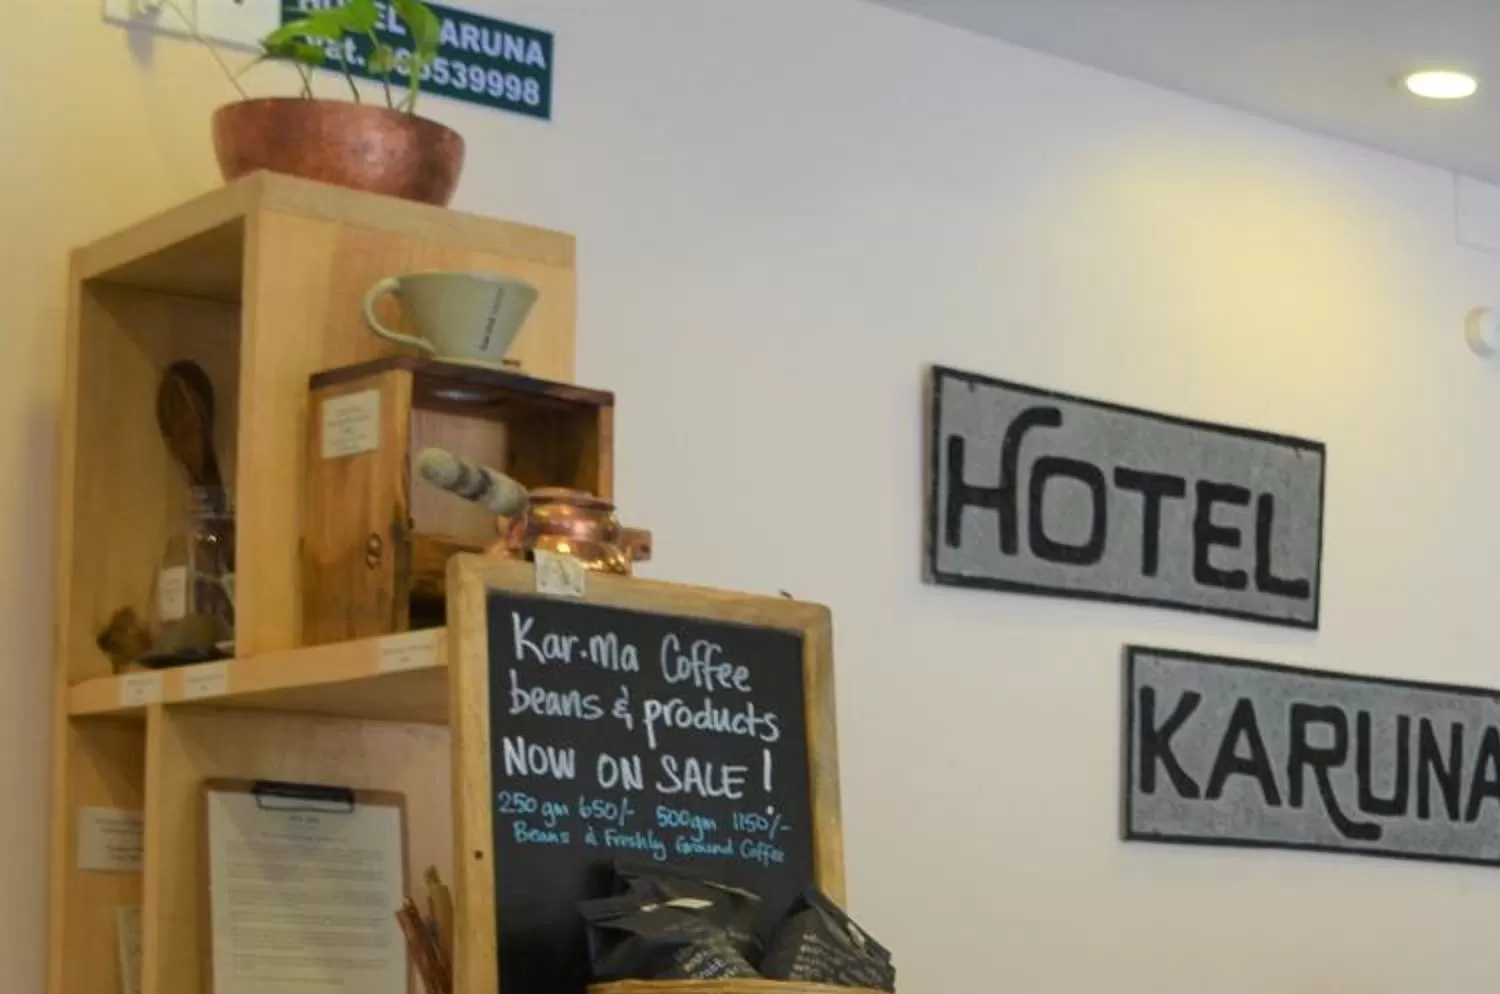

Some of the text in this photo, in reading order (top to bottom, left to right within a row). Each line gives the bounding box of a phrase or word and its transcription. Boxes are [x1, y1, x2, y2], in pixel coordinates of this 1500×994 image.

[416, 16, 547, 69] ARUNA
[945, 406, 1310, 600] HOTEL
[660, 633, 752, 693] Coffee
[509, 669, 604, 720] beans
[643, 698, 781, 750] products
[502, 736, 576, 780] NOW
[596, 752, 644, 791] ON
